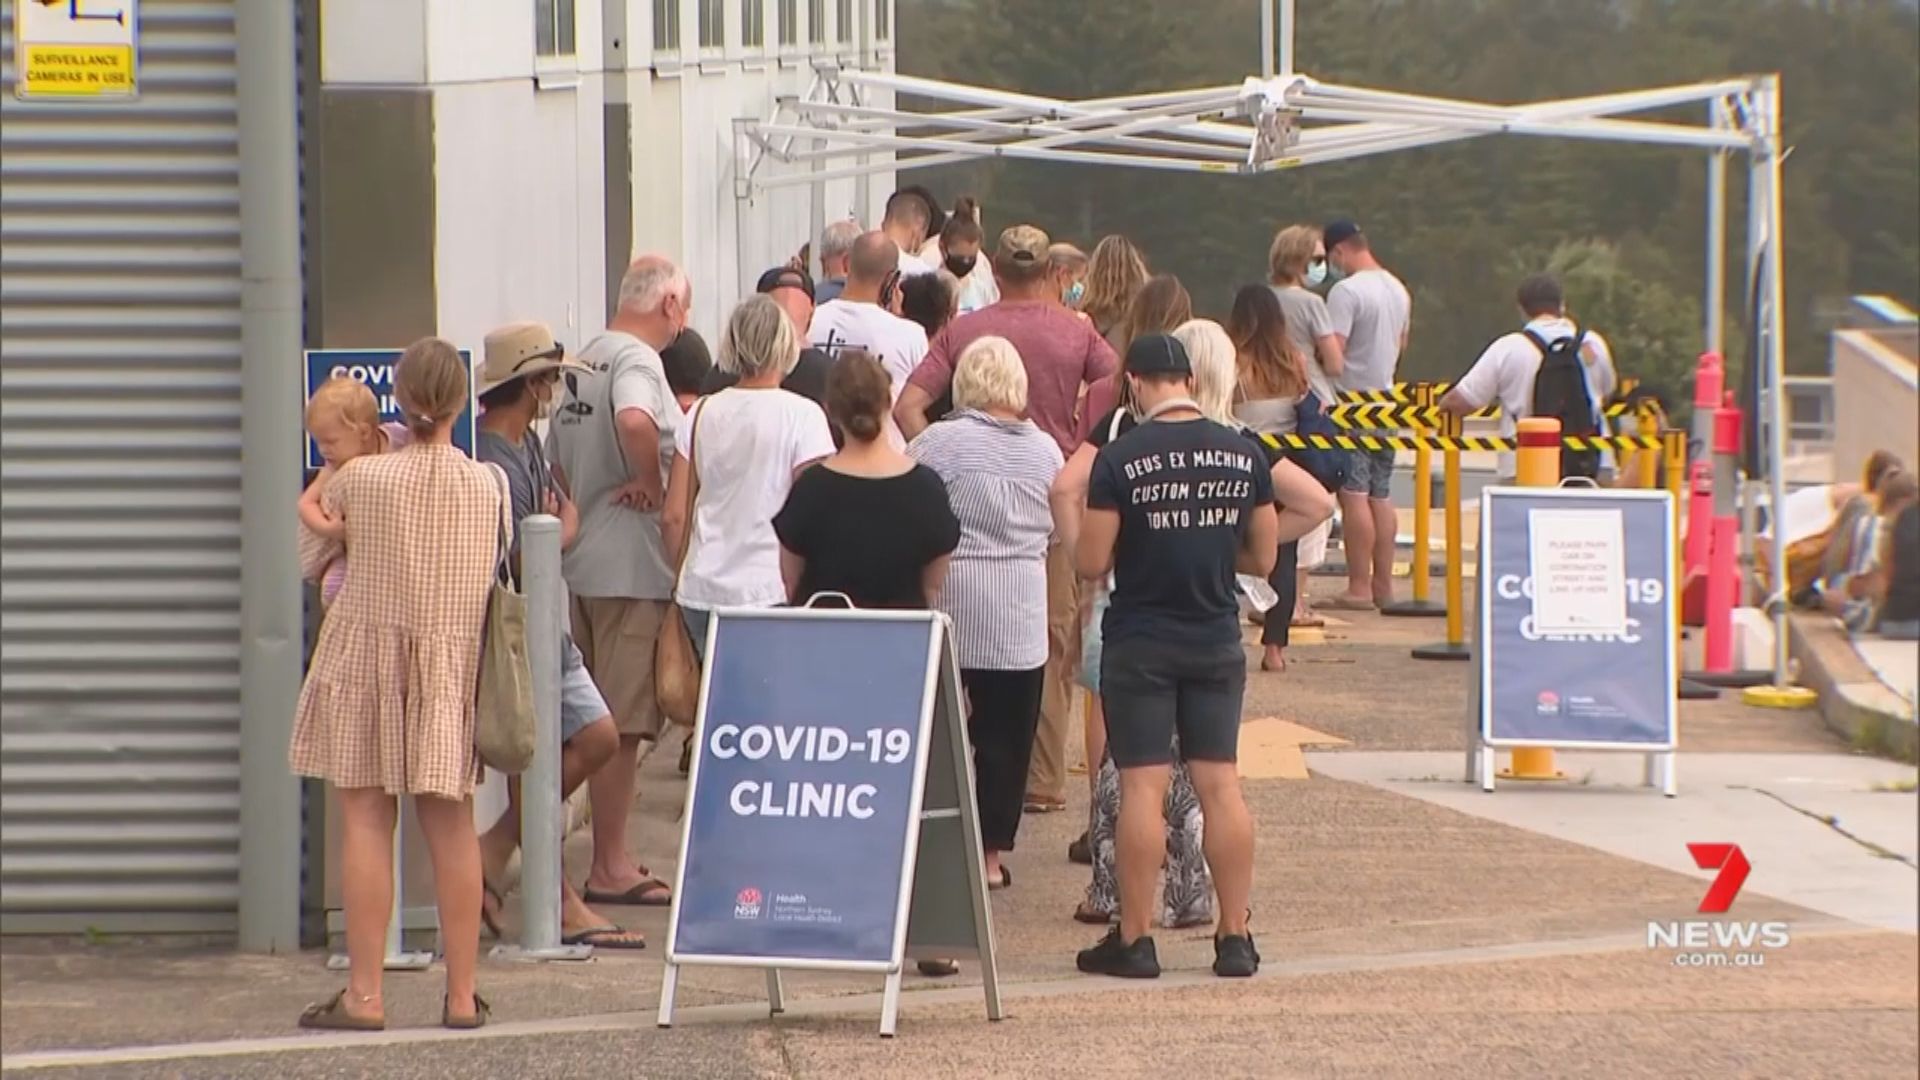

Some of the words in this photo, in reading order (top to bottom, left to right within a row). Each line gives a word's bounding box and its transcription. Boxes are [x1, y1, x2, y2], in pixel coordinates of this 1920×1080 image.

[33, 54, 118, 65] SURVEILLANCE
[27, 70, 82, 82] CAMERAS
[87, 72, 99, 82] IN
[103, 73, 125, 83] USE
[1124, 454, 1162, 480] DEUS
[1169, 452, 1186, 469] EX
[1193, 450, 1252, 473] MACHINA
[1132, 482, 1189, 504] CUSTOM
[1198, 480, 1249, 498] CYCLES
[1147, 510, 1190, 529] TOKYO
[1198, 508, 1239, 527] JAPAN
[710, 724, 911, 763] COVID-19
[730, 781, 877, 819] CLINIC
